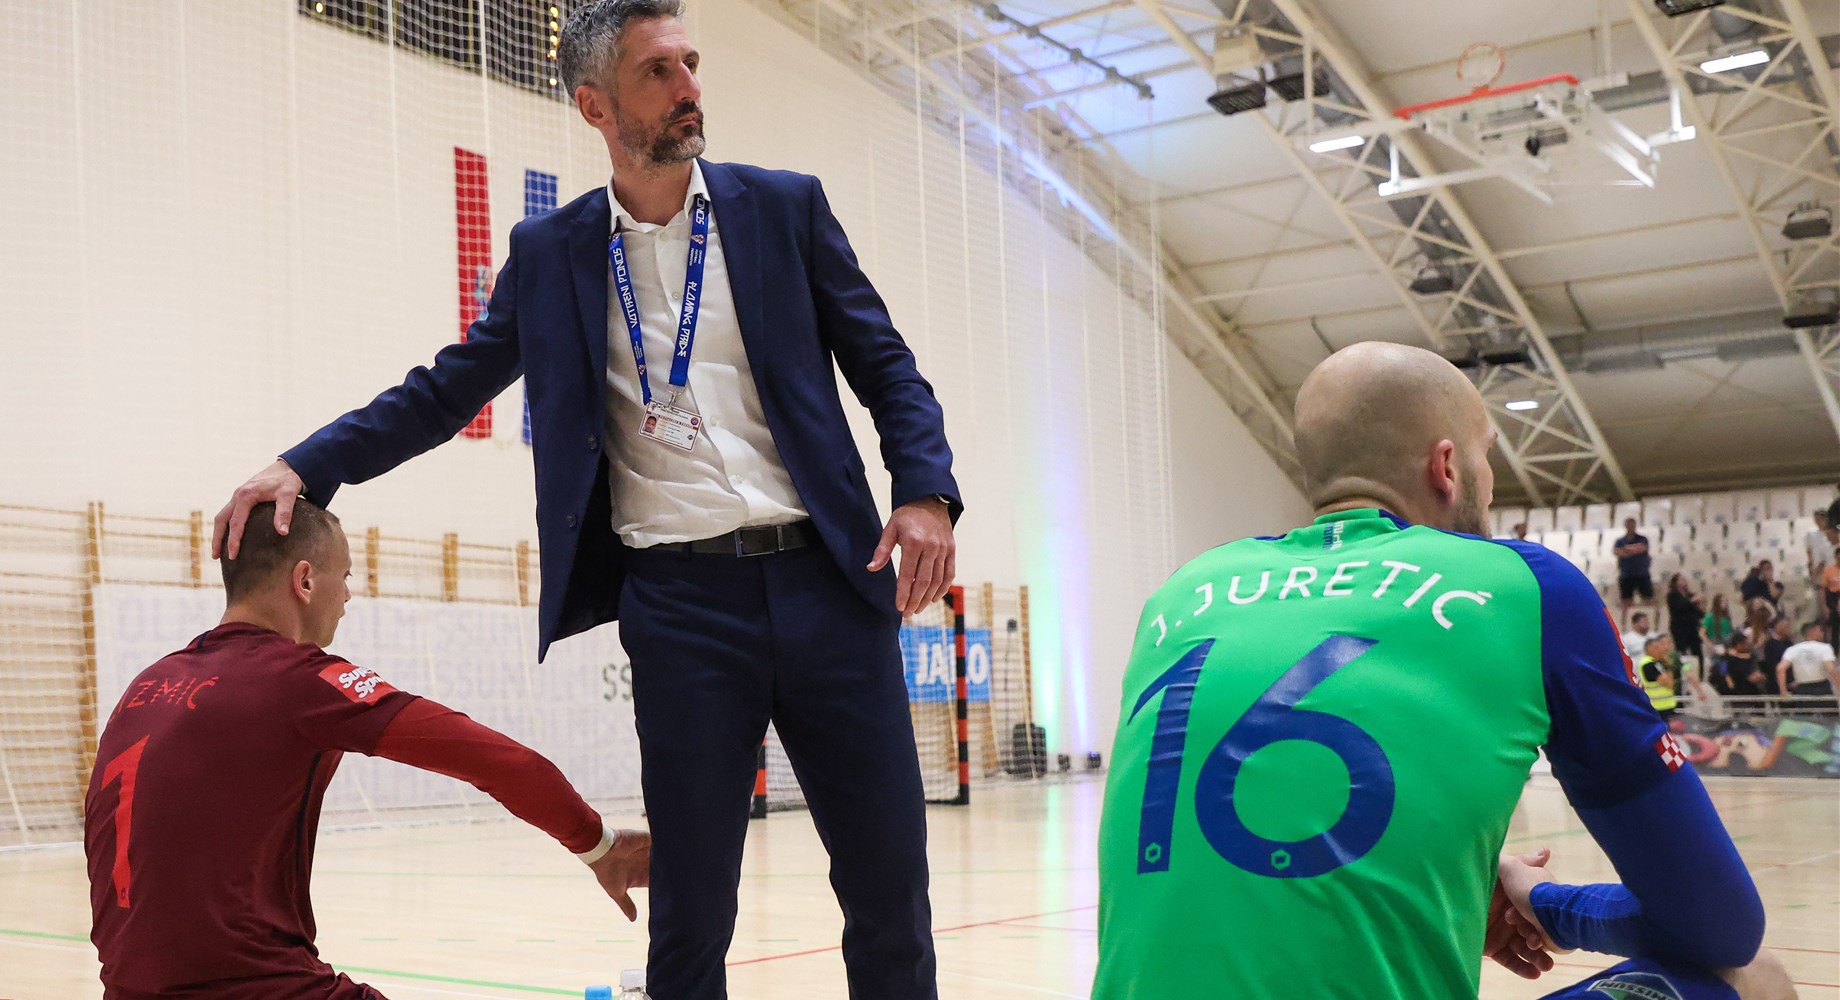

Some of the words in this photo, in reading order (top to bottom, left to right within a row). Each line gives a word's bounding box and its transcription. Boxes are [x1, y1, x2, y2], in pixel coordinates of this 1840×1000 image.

[695, 193, 706, 226] ONOS
[612, 247, 628, 284] PONOS
[620, 285, 639, 328] VATRENI
[1193, 560, 1493, 631] JURETIĆ
[1127, 633, 1396, 879] 16
[100, 734, 150, 908] 1
